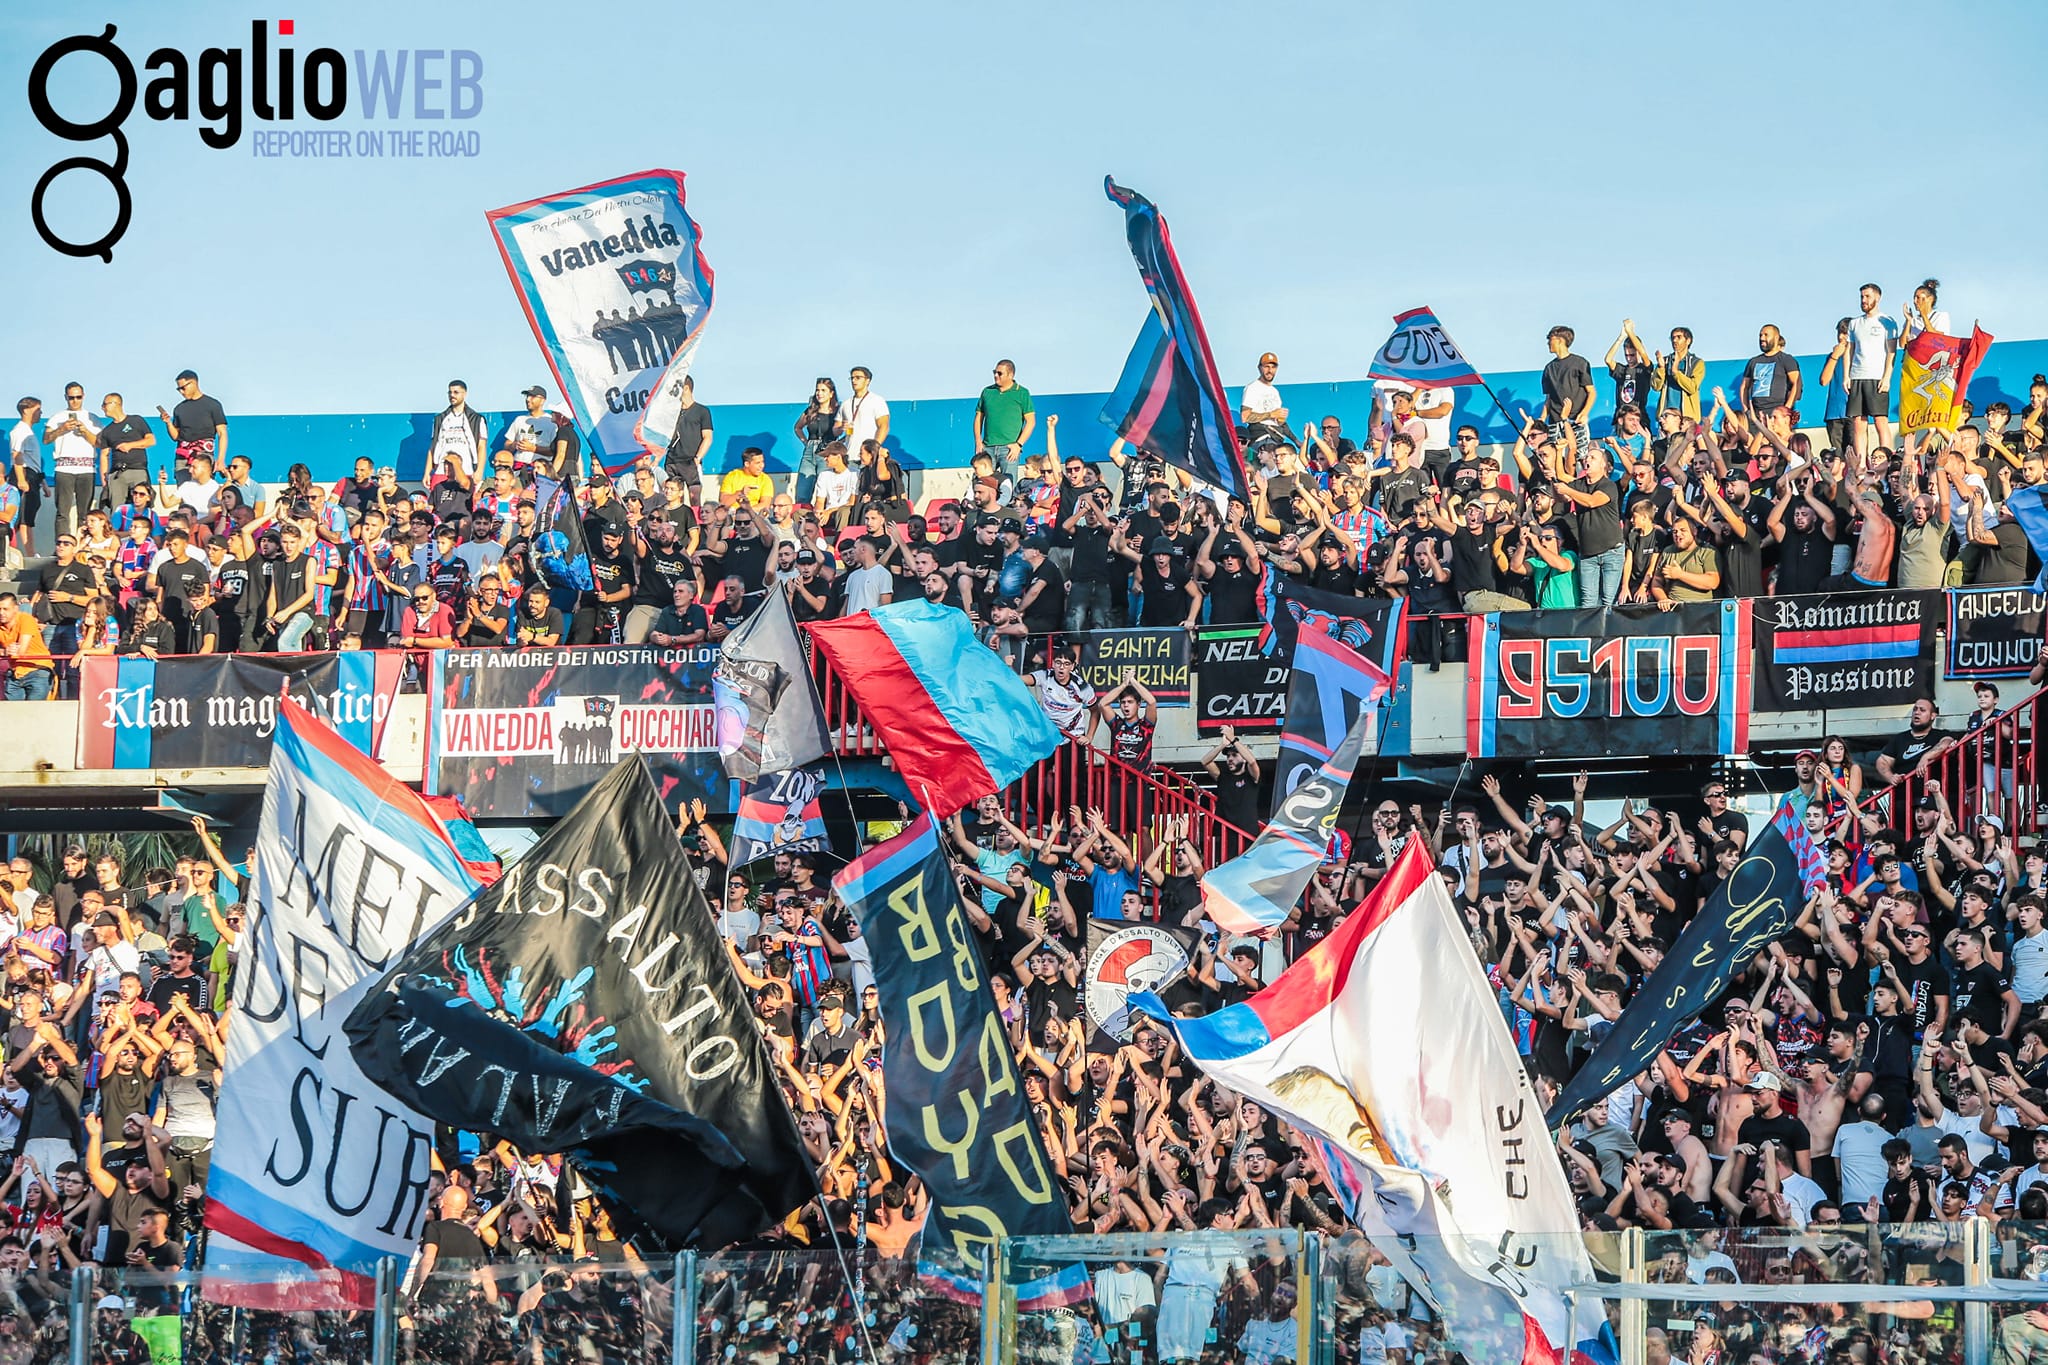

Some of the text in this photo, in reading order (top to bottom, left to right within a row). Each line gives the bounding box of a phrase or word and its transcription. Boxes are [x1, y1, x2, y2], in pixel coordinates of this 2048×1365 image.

[624, 267, 657, 286] 1946
[1774, 595, 1922, 630] Romantica
[448, 648, 722, 668] PER AMORE DEI NOSTRI COLOR
[1099, 637, 1171, 658] SANTA
[1203, 640, 1260, 663] NEL
[1958, 642, 2000, 667] CON
[1081, 664, 1189, 686] VENRINA
[1264, 667, 1290, 684] DI
[1497, 634, 1721, 719] 95100
[1785, 663, 1915, 700] Passione
[98, 685, 390, 738] Klan magtico
[1207, 692, 1287, 717] CATA
[445, 708, 719, 751] VANEDDA CUCCHIAR
[1907, 742, 1926, 752] NIKE
[1085, 947, 1109, 992] FALANGE
[1915, 980, 1932, 1028] CATANIA
[263, 1066, 433, 1241] SUR
